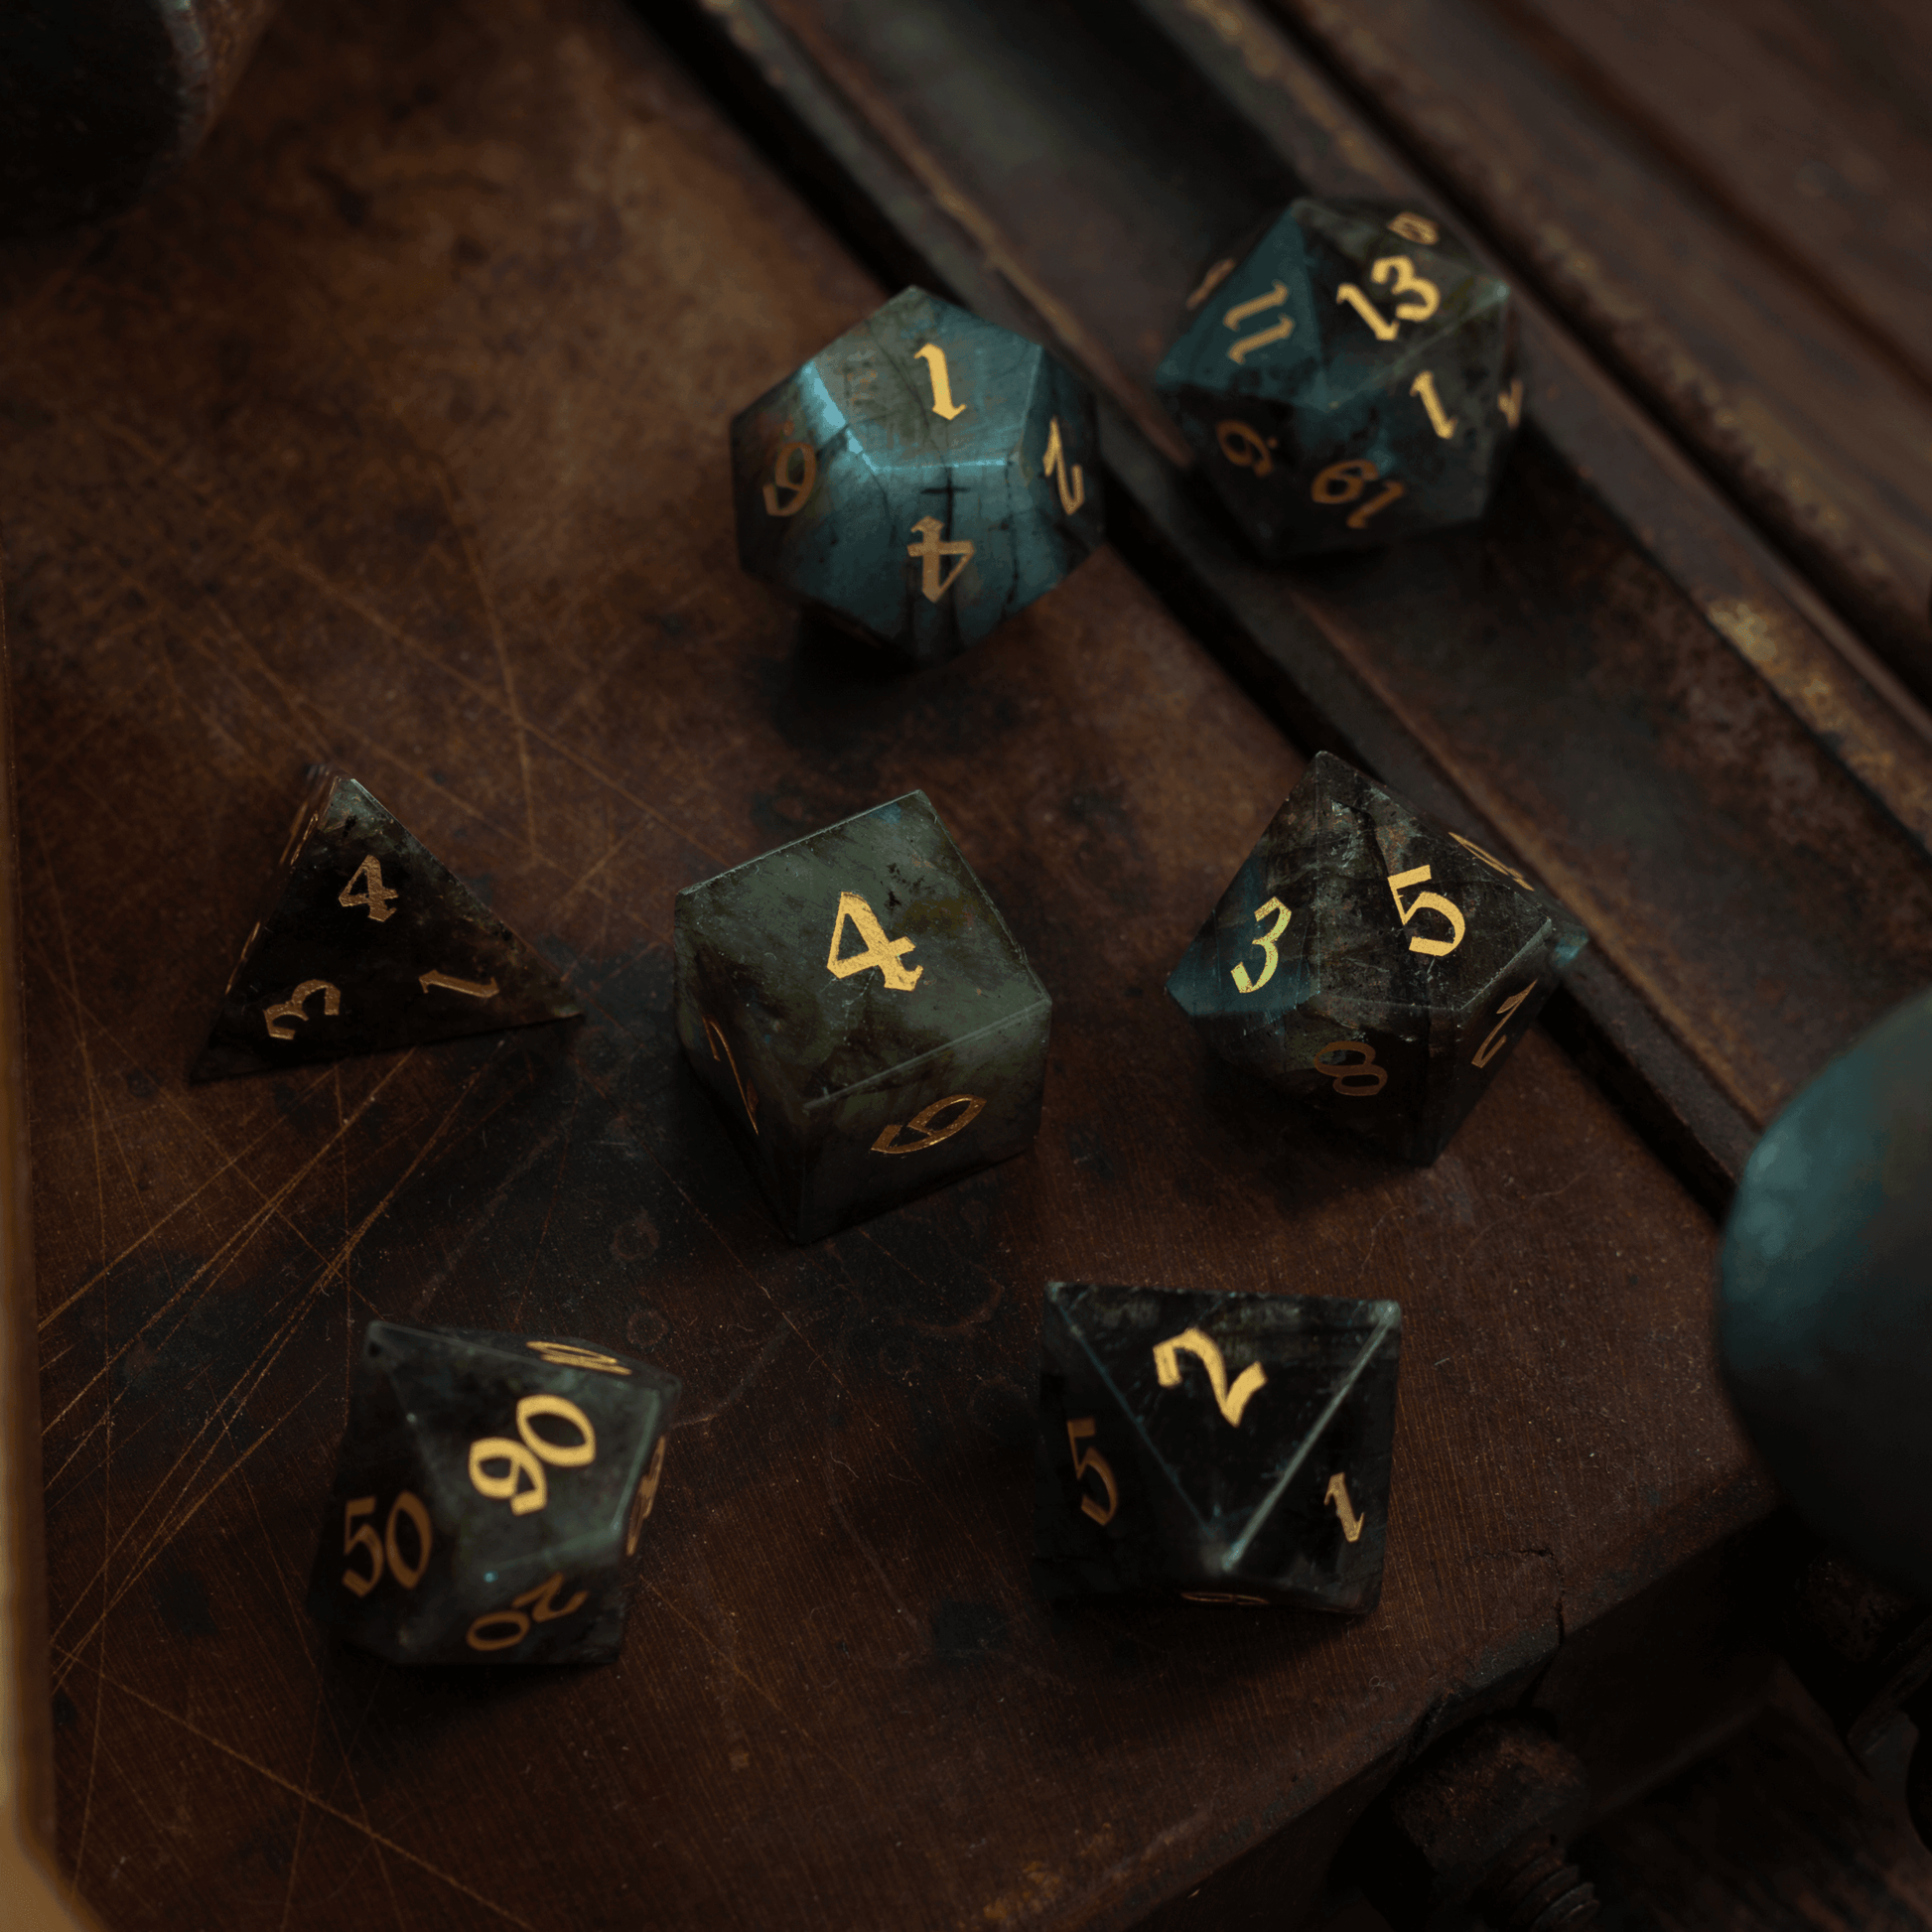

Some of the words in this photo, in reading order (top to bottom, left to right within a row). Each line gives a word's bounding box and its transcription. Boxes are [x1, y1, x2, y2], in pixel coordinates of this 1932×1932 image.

[1223, 279, 1295, 364] 11
[1336, 255, 1441, 341] 13
[914, 343, 967, 421] 1
[1410, 370, 1457, 439] 1
[907, 516, 975, 603] 4
[339, 855, 398, 922] 4
[1388, 865, 1465, 957] 5
[419, 969, 499, 999] 1
[827, 892, 924, 991] 4
[1230, 896, 1292, 993] 3
[263, 979, 341, 1040] 3
[1313, 1040, 1388, 1096] 8
[1152, 1326, 1269, 1428] 2
[468, 1394, 596, 1516] 90
[1066, 1418, 1119, 1526] 5
[342, 1490, 433, 1598] 50
[1323, 1472, 1364, 1543] 1
[467, 1573, 589, 1651] 20
